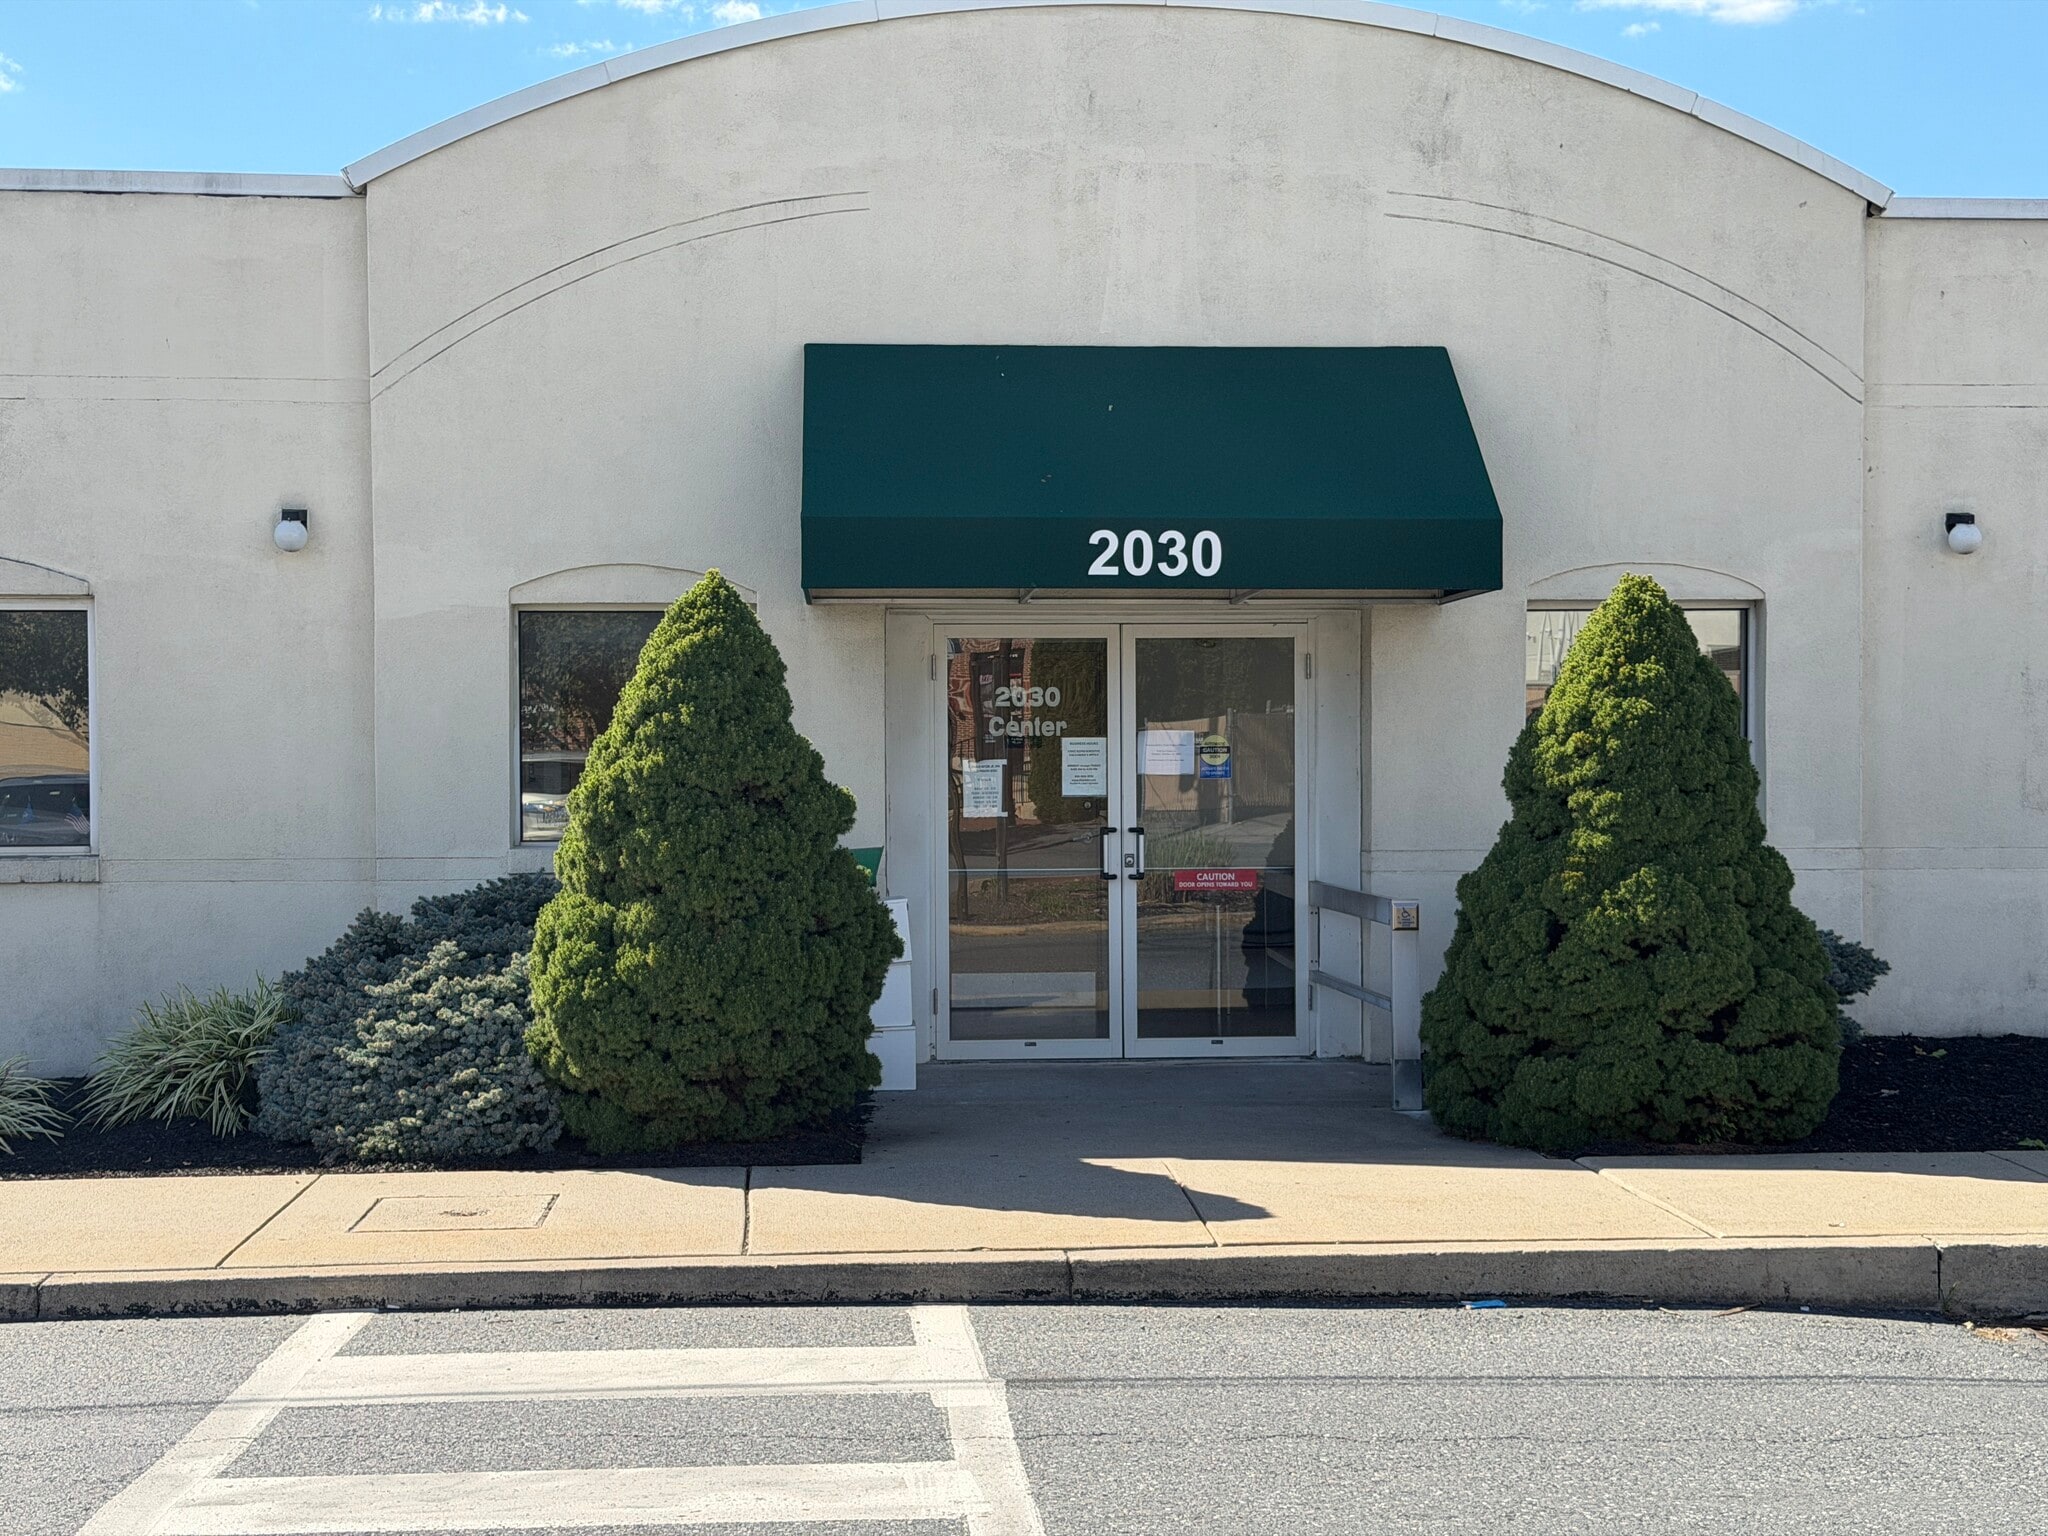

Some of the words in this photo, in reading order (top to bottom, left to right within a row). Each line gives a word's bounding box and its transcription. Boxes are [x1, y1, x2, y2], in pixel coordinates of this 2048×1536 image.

[1088, 529, 1222, 577] 2030
[994, 686, 1061, 708] 2030
[988, 716, 1068, 737] Center
[1196, 872, 1235, 881] CAUTION
